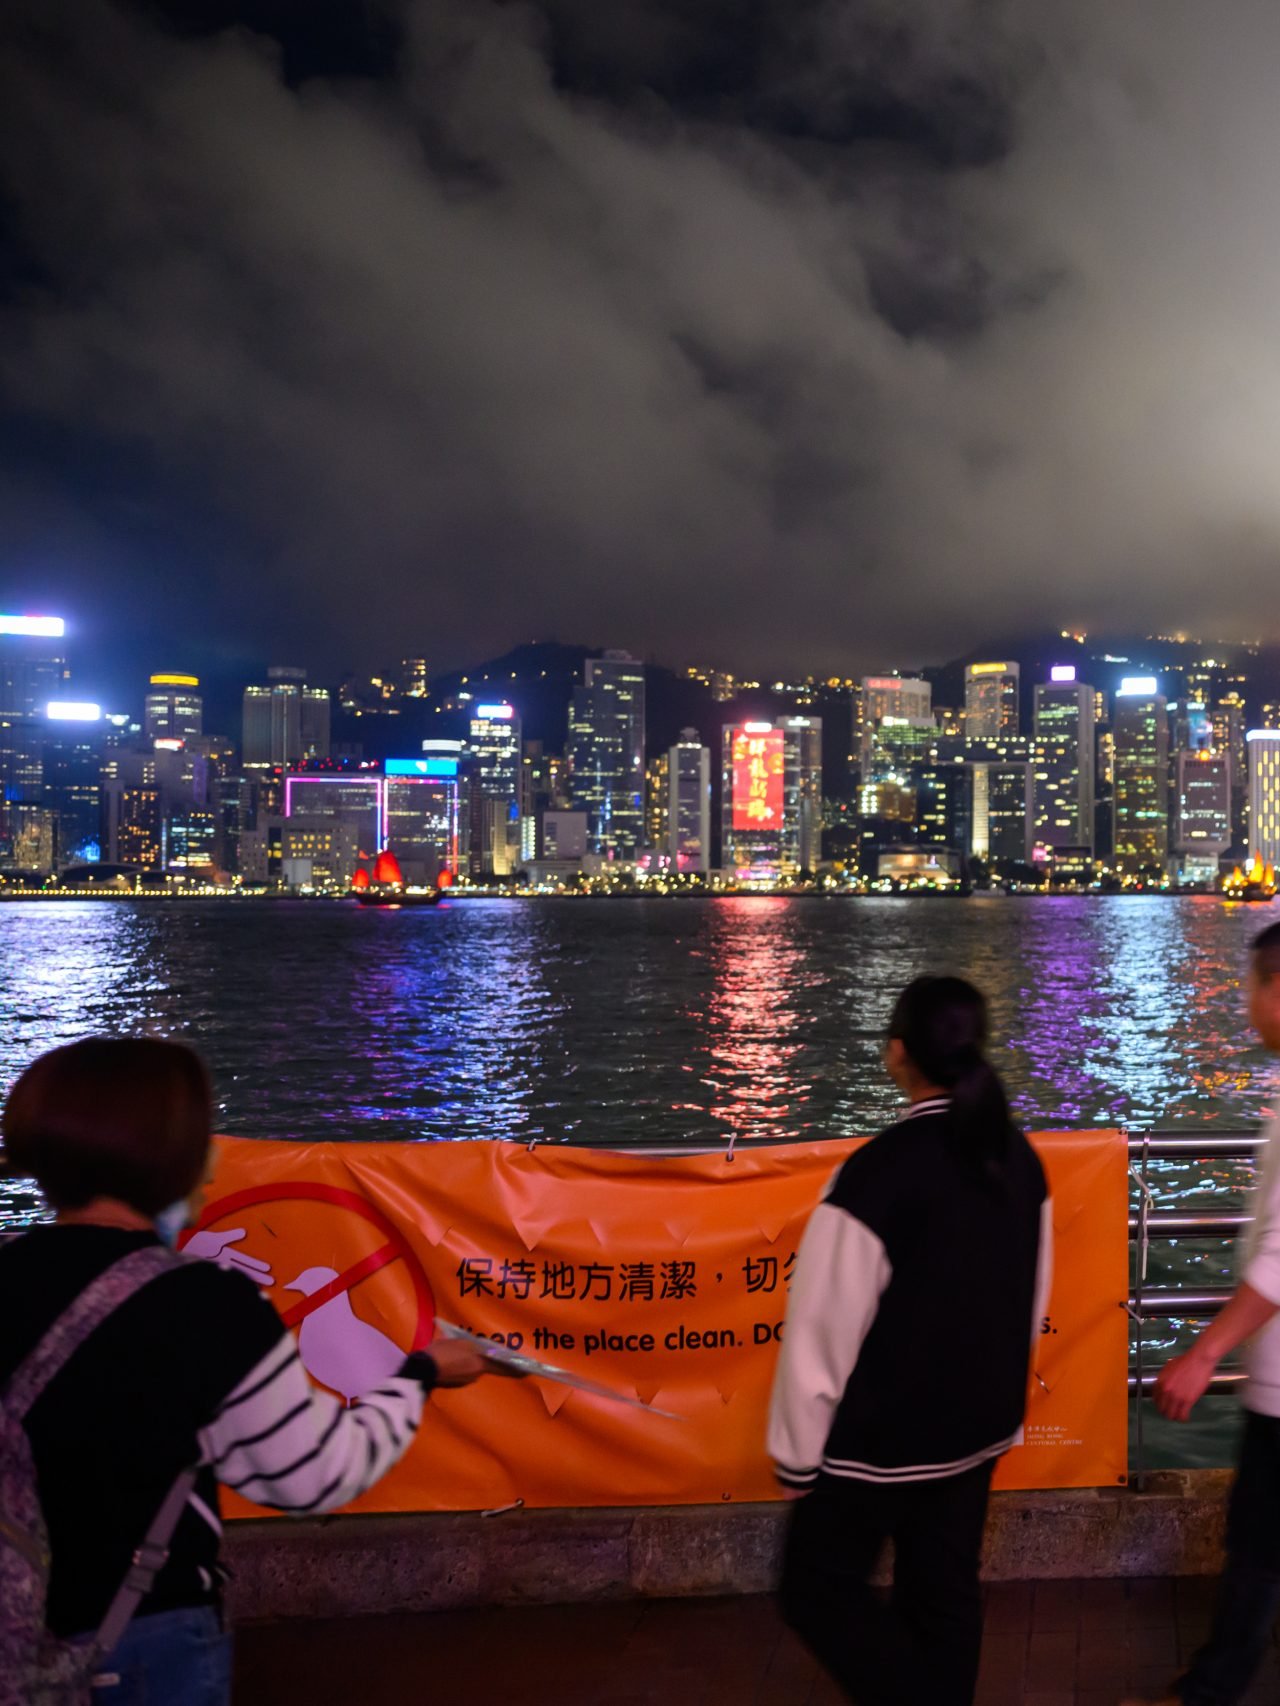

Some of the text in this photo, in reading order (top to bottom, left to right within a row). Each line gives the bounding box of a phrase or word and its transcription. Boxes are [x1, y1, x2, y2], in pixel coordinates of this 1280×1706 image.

[533, 1326, 575, 1350] the
[584, 1328, 655, 1355] place
[664, 1325, 743, 1350] clean.
